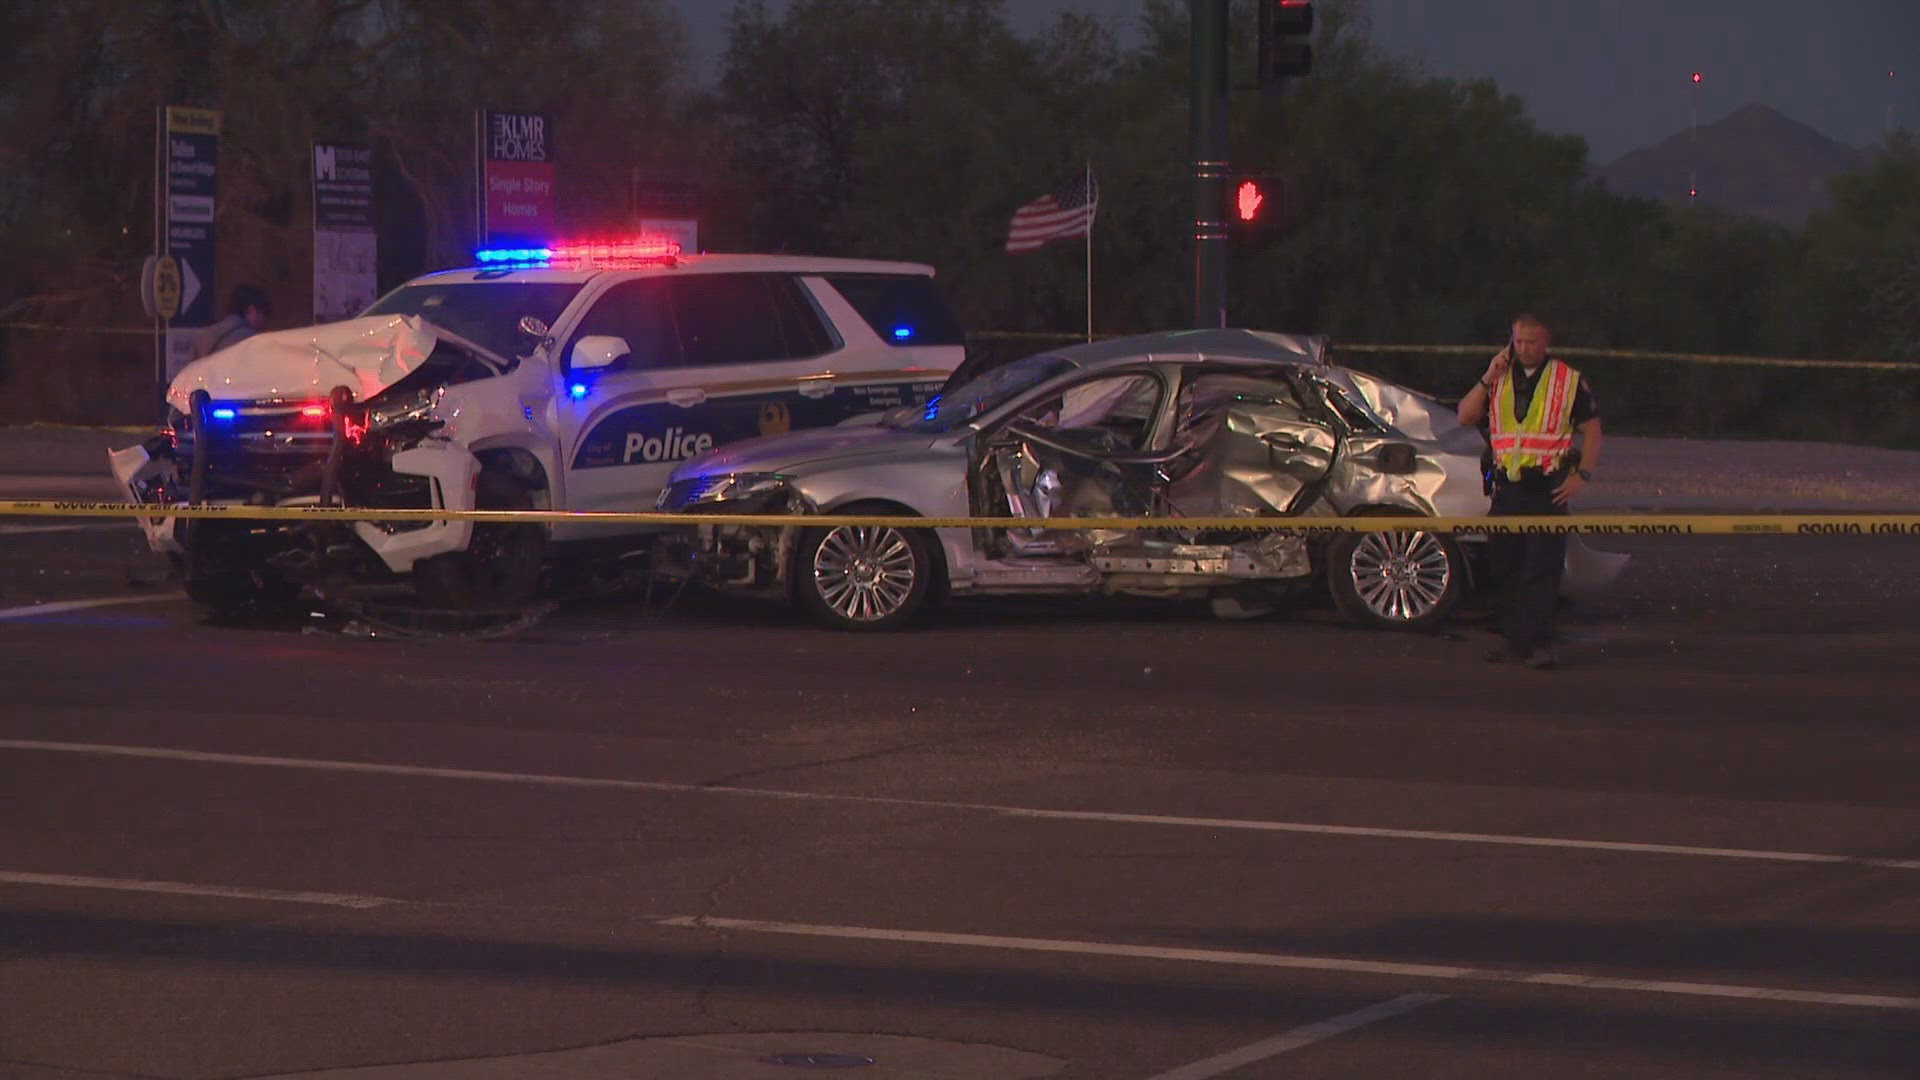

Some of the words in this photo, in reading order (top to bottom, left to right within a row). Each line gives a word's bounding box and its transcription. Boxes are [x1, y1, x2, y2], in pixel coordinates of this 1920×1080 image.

[501, 114, 545, 140] KLMR
[494, 138, 546, 161] HOMES
[314, 145, 337, 180] M
[489, 177, 521, 195] Single
[523, 178, 551, 195] Story
[503, 201, 538, 216] Homes
[623, 427, 713, 463] Police
